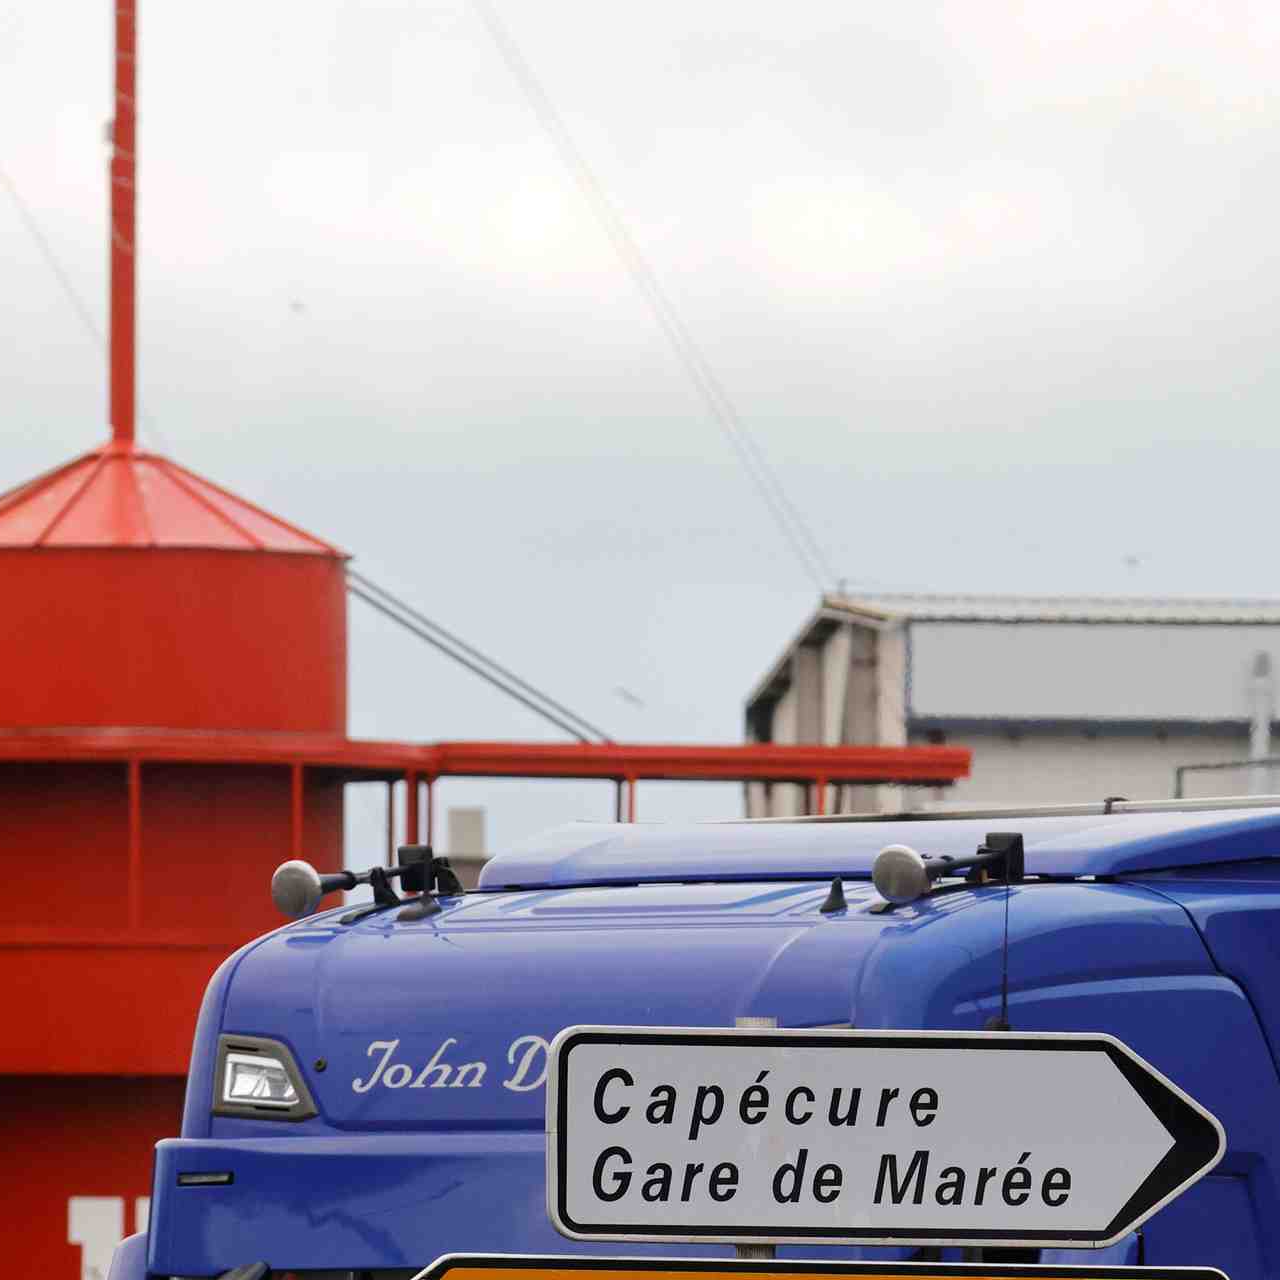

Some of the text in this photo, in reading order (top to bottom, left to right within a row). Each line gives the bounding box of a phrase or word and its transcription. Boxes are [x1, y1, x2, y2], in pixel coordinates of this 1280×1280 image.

[352, 1038, 487, 1093] John
[592, 1067, 939, 1140] Capécure
[592, 1146, 1072, 1207] Gare de Marée
